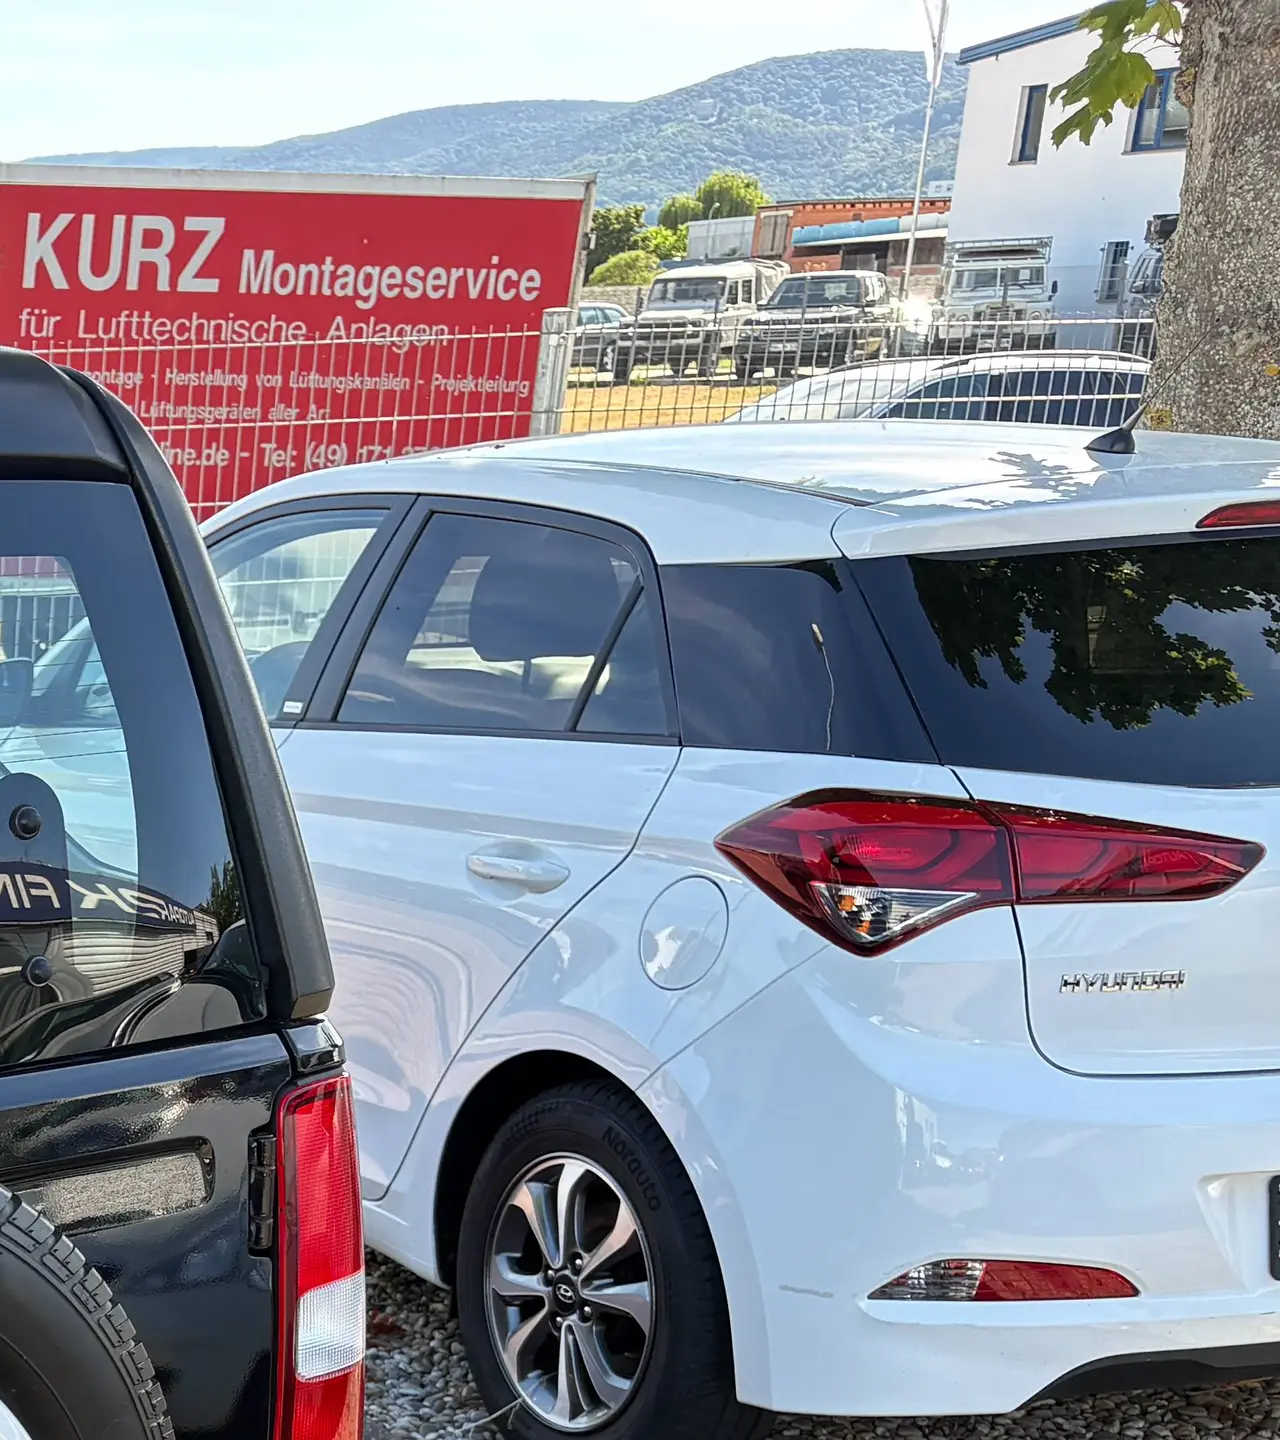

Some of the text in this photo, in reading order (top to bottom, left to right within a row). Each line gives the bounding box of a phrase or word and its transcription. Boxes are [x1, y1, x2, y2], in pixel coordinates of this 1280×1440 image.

[22, 212, 541, 310] KURZ Montageservice
[19, 308, 449, 351] für Lufttechnische Anlagen
[165, 368, 248, 391] Herstellung
[256, 373, 282, 388] von
[289, 370, 410, 393] Lüftungskanälen
[268, 403, 301, 421] aller
[304, 442, 347, 470] (49)
[1059, 969, 1186, 993] HYUNDAI
[600, 1124, 662, 1212] Norauto
